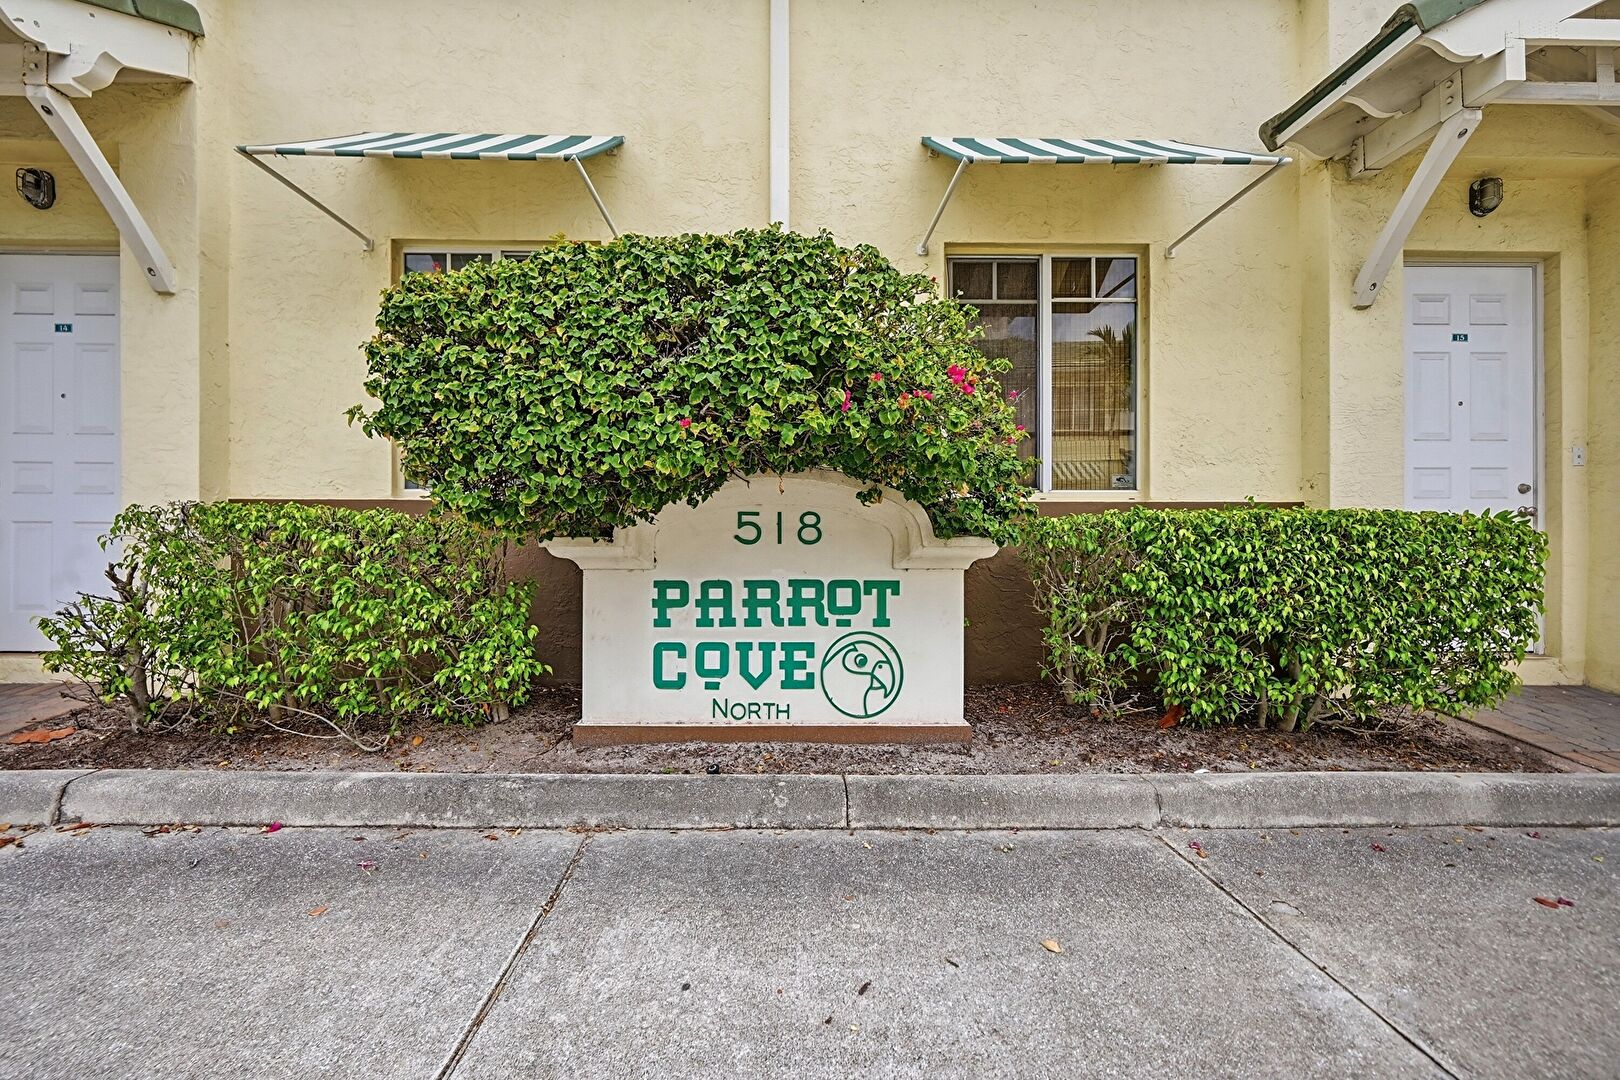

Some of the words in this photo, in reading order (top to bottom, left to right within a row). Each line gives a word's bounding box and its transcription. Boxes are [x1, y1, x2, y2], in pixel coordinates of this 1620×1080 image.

[734, 511, 822, 545] 518
[651, 578, 901, 628] PARROT
[652, 641, 816, 690] COVE
[712, 698, 790, 720] NORTH
